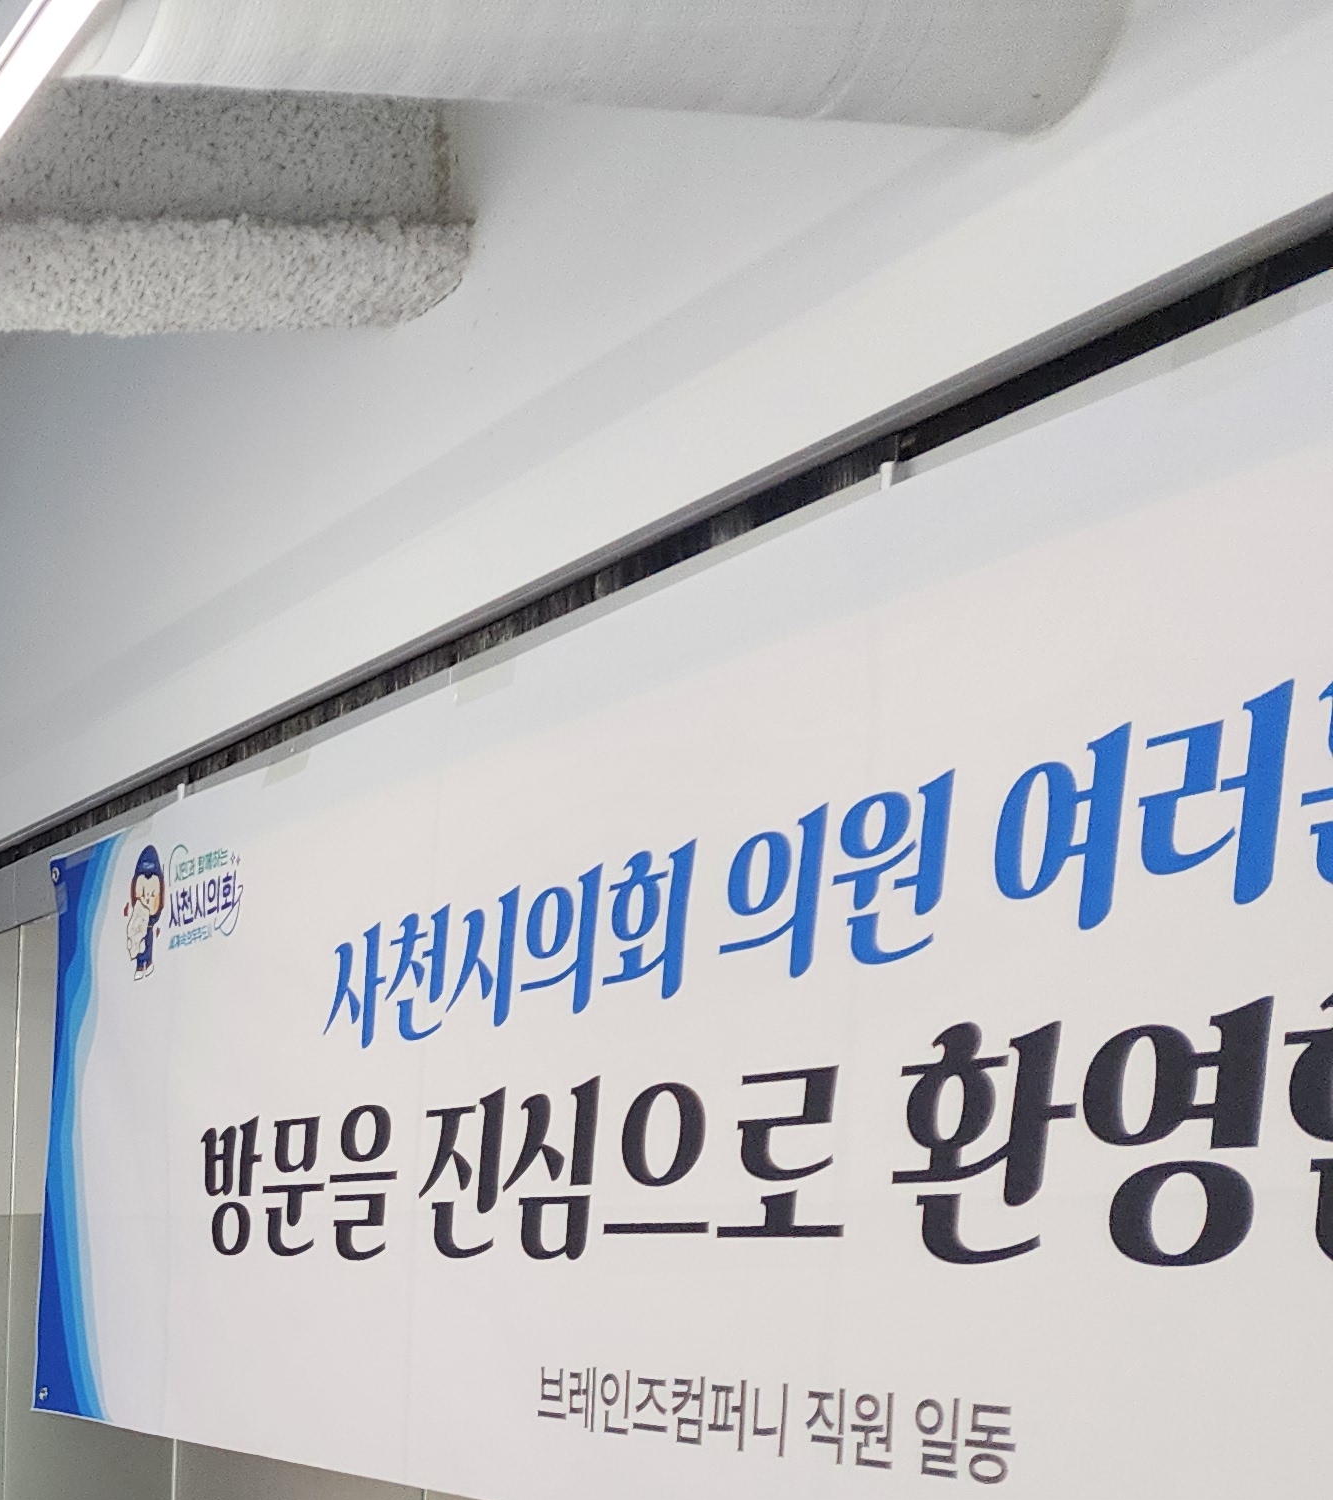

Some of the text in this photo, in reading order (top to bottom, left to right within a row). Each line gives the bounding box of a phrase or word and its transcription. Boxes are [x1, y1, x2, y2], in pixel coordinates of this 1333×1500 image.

[168, 869, 237, 929] 사천시의회
[322, 678, 1333, 1049] 사천시의회 의원 여러
[200, 994, 1333, 1267] 방문을 진심으로 환영
[536, 1365, 1017, 1485] 브레인즈컴퍼니 직원 일동
